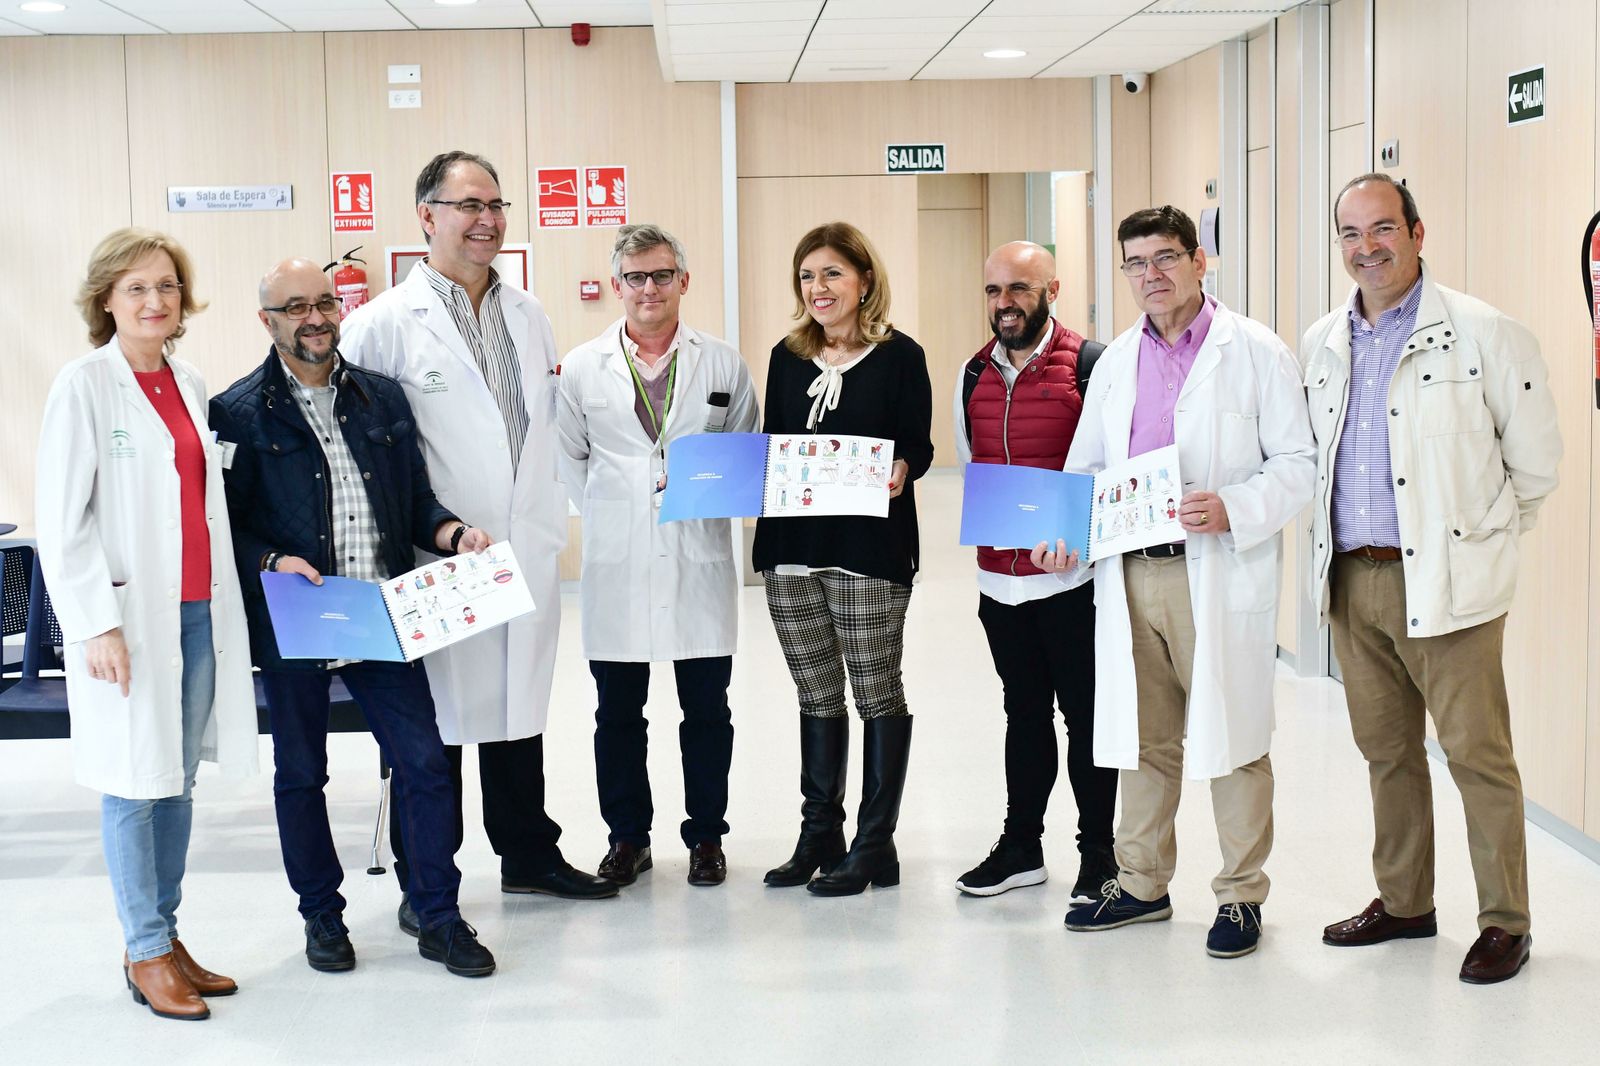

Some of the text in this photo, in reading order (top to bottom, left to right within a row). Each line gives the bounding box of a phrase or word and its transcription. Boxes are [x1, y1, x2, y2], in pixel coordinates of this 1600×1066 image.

[1522, 79, 1543, 110] SALIDA
[889, 148, 943, 169] SALIDA
[196, 190, 266, 202] Sala de Espera
[335, 218, 372, 227] EXTINTOR
